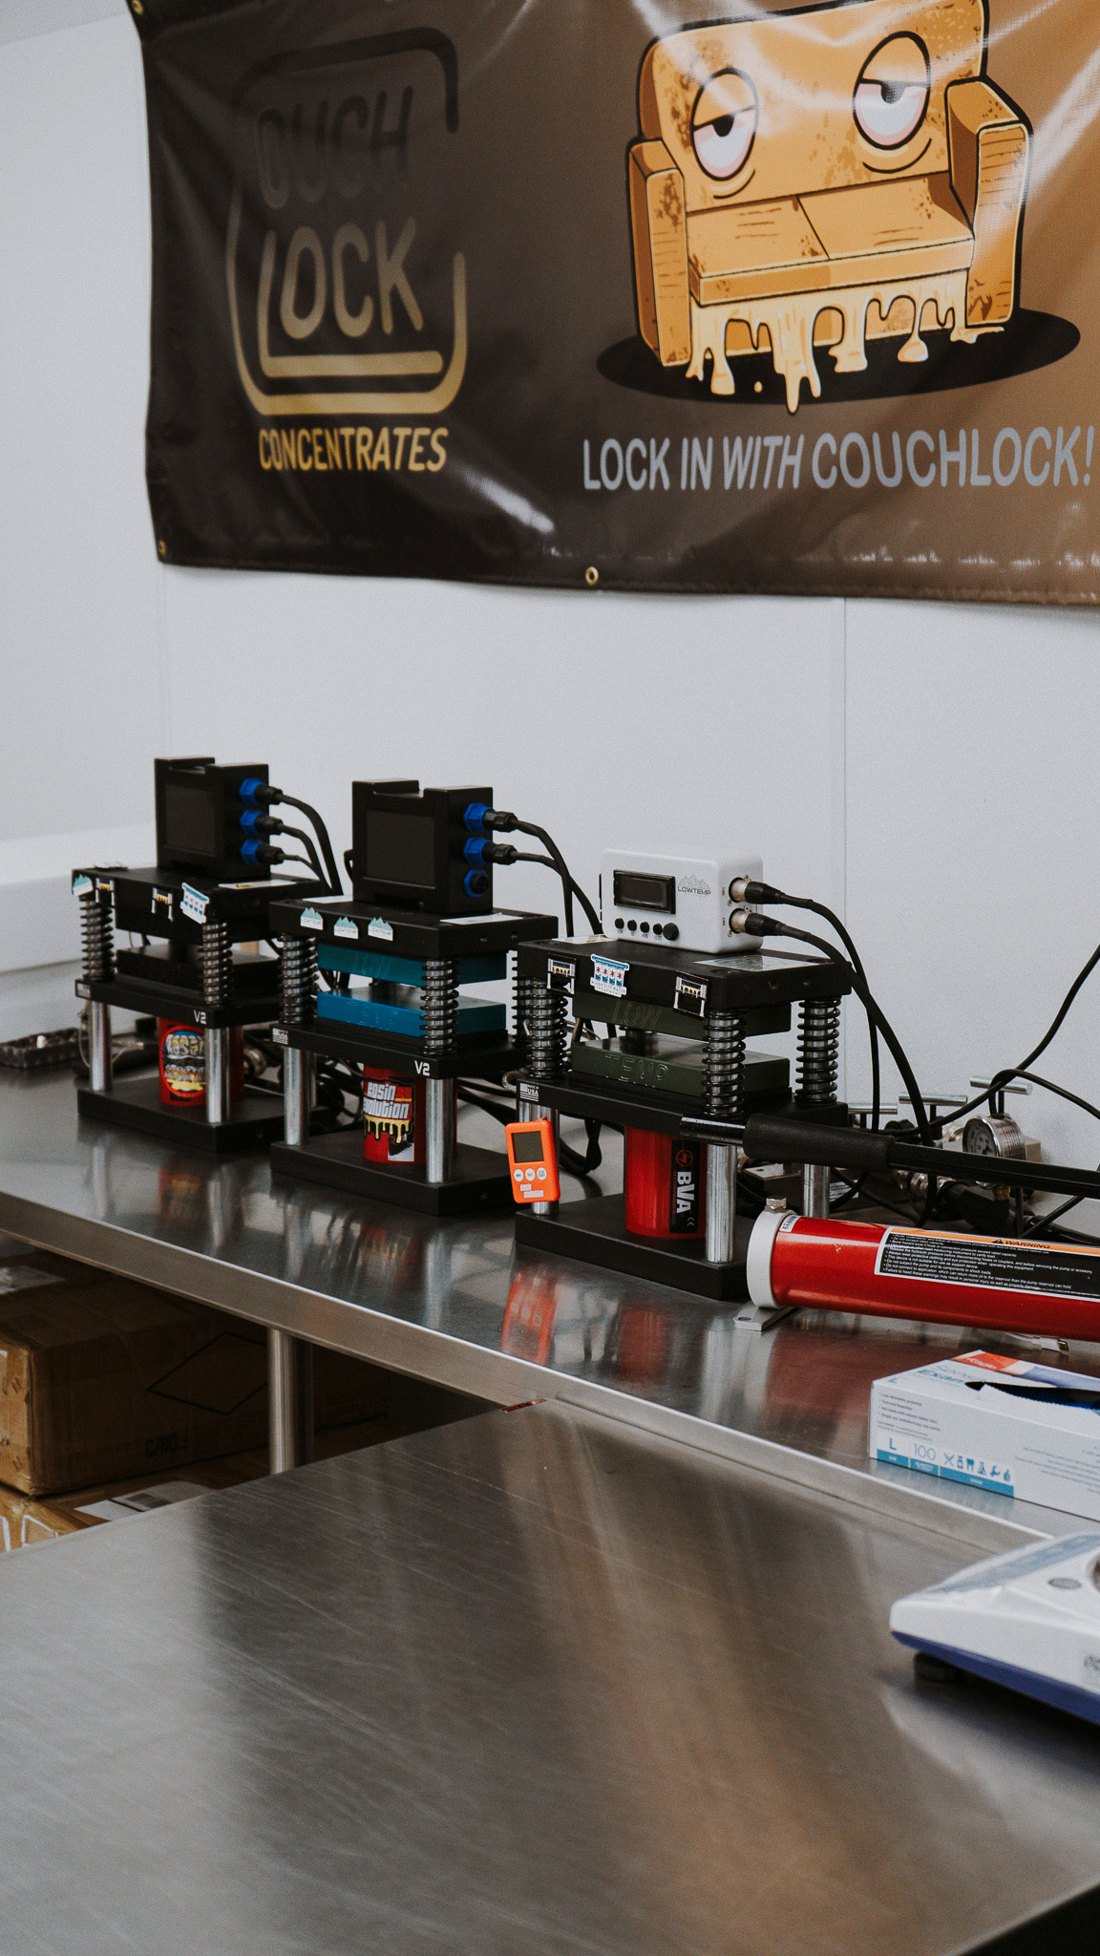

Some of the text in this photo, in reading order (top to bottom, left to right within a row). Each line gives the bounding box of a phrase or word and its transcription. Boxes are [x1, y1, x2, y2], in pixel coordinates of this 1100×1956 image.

[256, 215, 445, 378] LOCK
[258, 426, 451, 473] CONCENTRATES
[583, 425, 1096, 491] LOCK IN WITH COUCHLOCK!
[677, 886, 712, 896] LOWTEMP
[193, 1009, 207, 1025] V2
[414, 1060, 430, 1077] V2
[604, 1052, 669, 1088] TEMP
[676, 1171, 695, 1214] BVA
[1004, 1240, 1051, 1249] WARNING
[889, 1437, 897, 1451] L
[913, 1443, 937, 1461] 100
